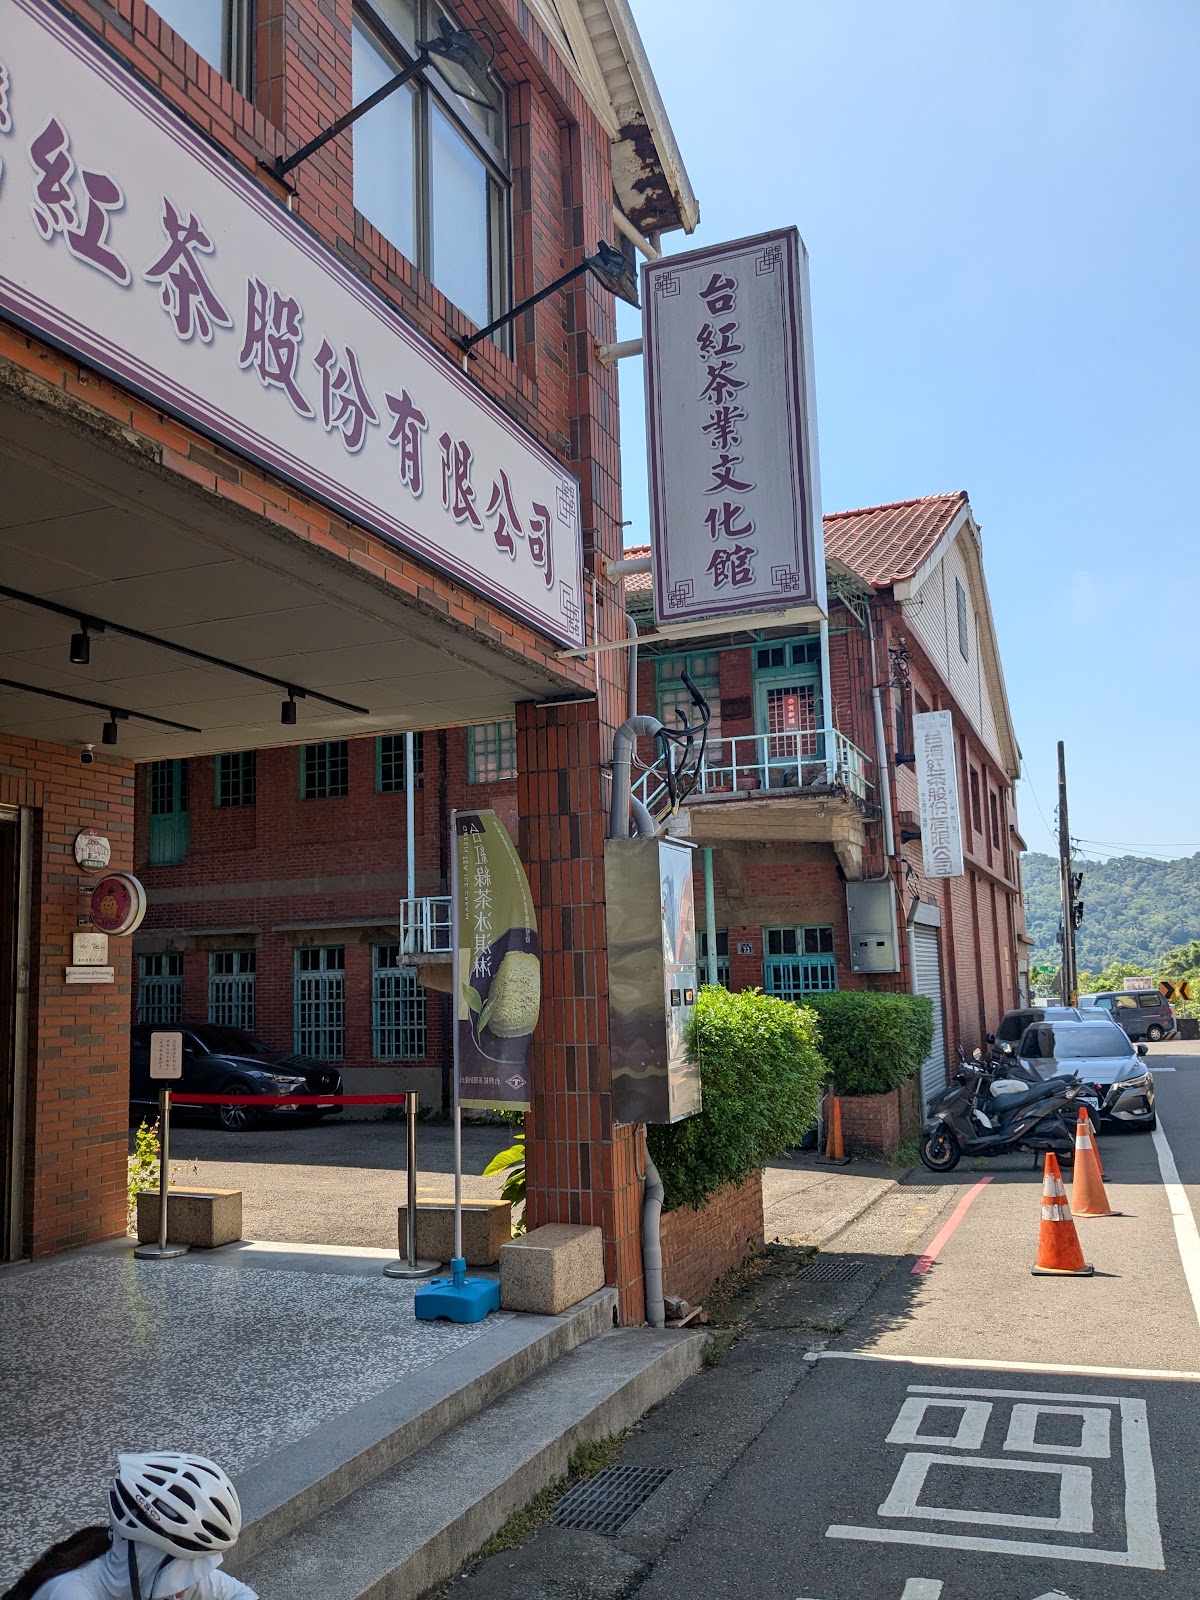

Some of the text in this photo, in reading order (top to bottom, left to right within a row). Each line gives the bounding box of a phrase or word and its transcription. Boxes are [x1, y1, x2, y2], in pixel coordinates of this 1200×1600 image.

[0, 62, 556, 585] 紅茶股份有限公司
[696, 272, 755, 589] 台紅茶業文化館
